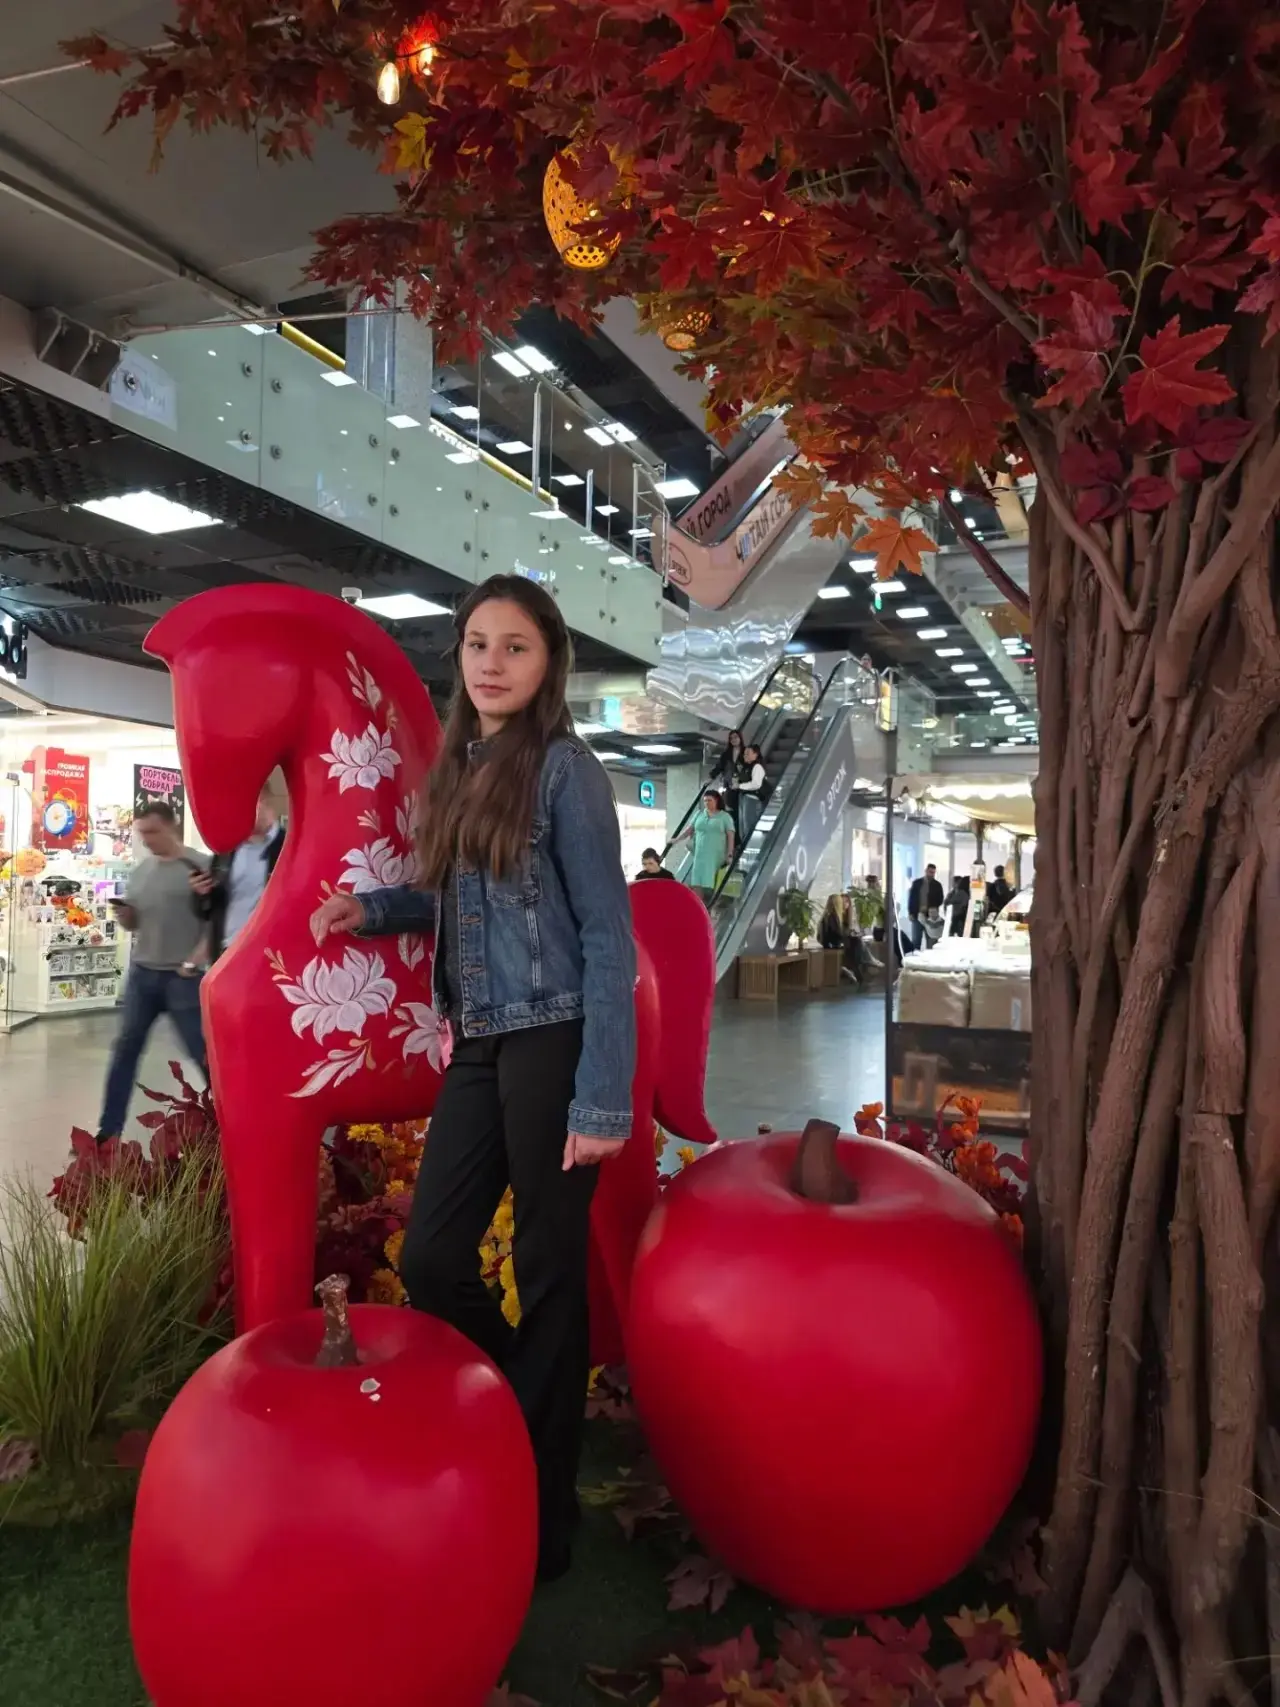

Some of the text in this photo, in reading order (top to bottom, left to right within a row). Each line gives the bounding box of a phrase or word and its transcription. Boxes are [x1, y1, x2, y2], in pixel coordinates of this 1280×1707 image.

[697, 485, 732, 536] ГОРОД
[143, 769, 180, 784] ПОРТФЕЛЬ
[142, 779, 170, 792] СОБРАЛ
